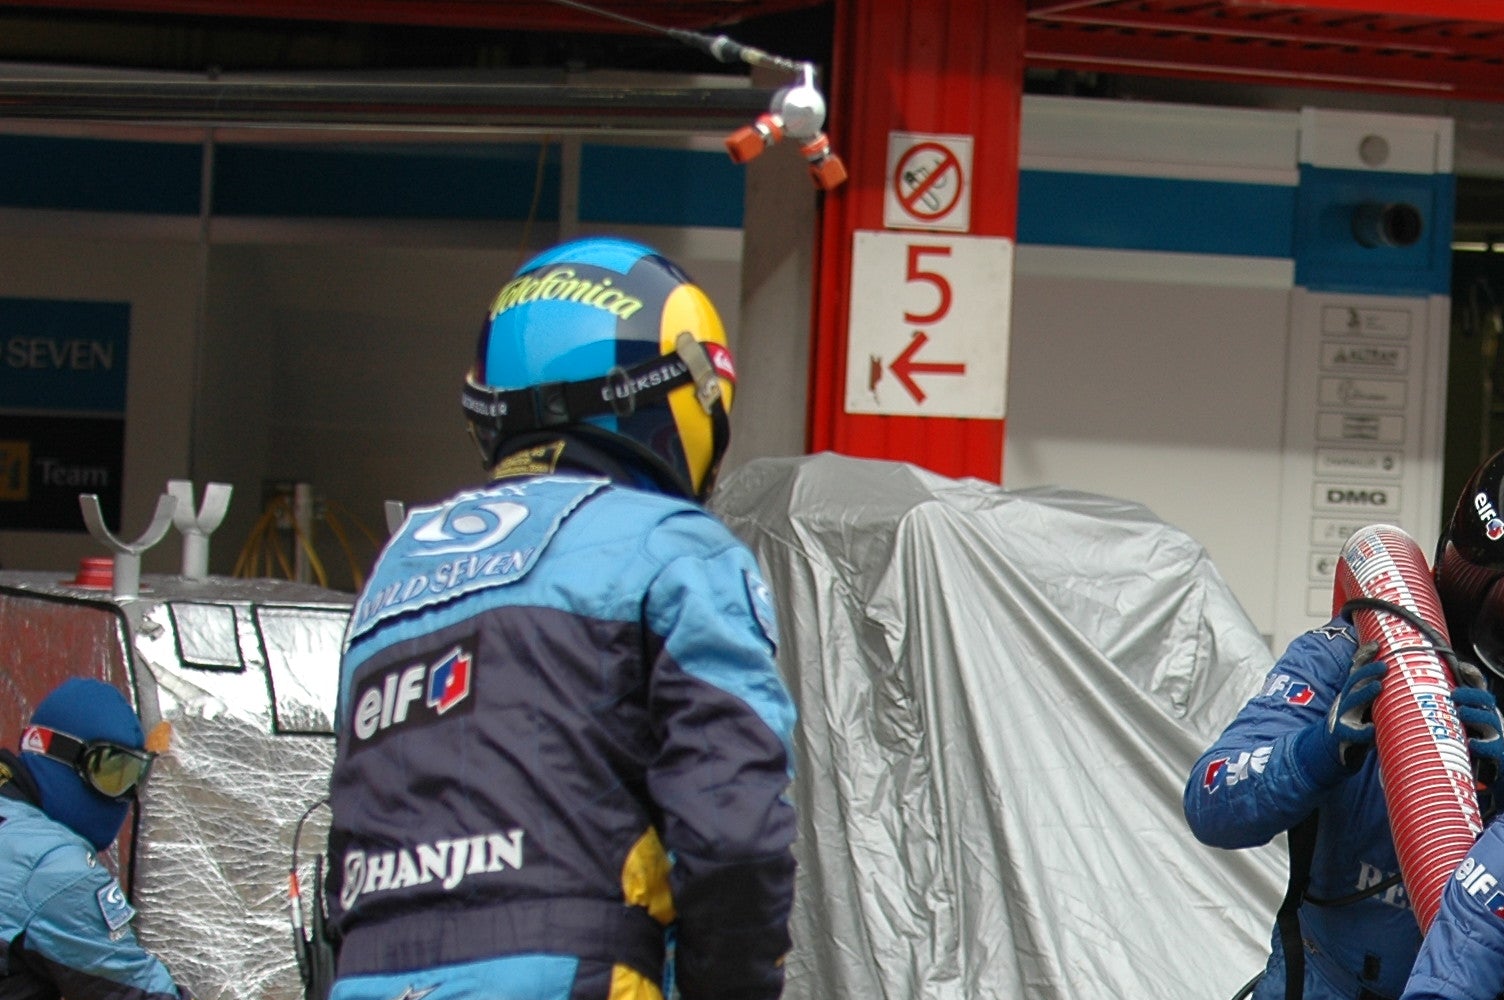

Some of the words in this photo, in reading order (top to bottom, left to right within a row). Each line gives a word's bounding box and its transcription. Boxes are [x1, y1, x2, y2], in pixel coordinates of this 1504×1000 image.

[903, 245, 953, 326] 5
[7, 336, 113, 371] SEVEN
[36, 457, 109, 486] Team
[1326, 489, 1388, 506] DMG
[1474, 491, 1498, 525] elf
[431, 546, 535, 597] SEVEN
[354, 663, 427, 741] elf
[362, 829, 525, 890] HANJIN
[1455, 857, 1497, 899] elf
